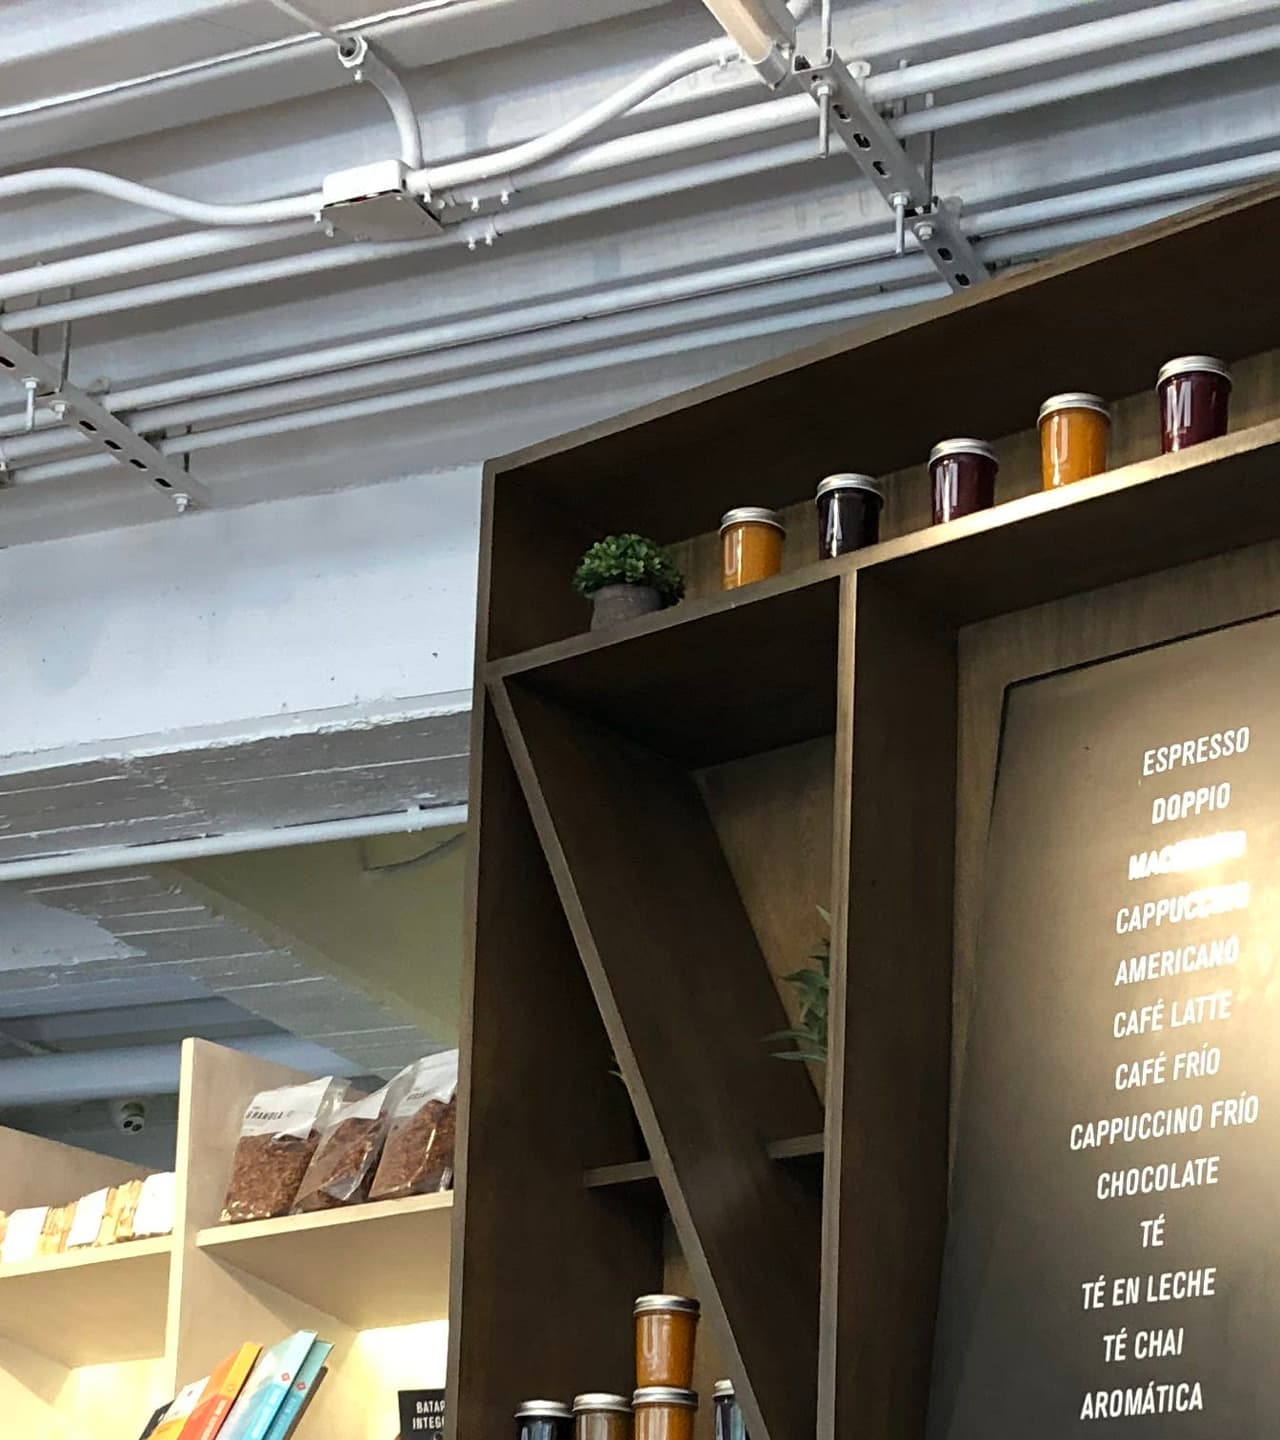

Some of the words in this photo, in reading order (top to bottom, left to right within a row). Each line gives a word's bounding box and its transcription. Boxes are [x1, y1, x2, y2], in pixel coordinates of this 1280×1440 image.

[1166, 380, 1192, 433] M
[1142, 727, 1250, 776] ESPRESSO
[1152, 783, 1231, 824] DOPPIO
[1116, 882, 1250, 934] CAPPUCC
[1114, 934, 1240, 986] AMERICANO
[1113, 998, 1164, 1038] CAFÉ
[1170, 990, 1232, 1028] LATTE
[1115, 1051, 1166, 1090] CAFÉ
[1173, 1043, 1220, 1081] FRÍO
[1070, 1105, 1204, 1150] CAPPUCCINO
[1210, 1092, 1259, 1128] FRÍO
[1097, 1156, 1220, 1200] CHOCOLATE
[1140, 1213, 1166, 1248] TÉ
[1082, 1275, 1107, 1310] TÉ
[1112, 1275, 1141, 1306] EN
[1147, 1268, 1216, 1303] LECHE
[1103, 1327, 1128, 1362] TÉ
[1135, 1328, 1184, 1360] CHAI
[1080, 1381, 1204, 1420] AROMÁTICA
